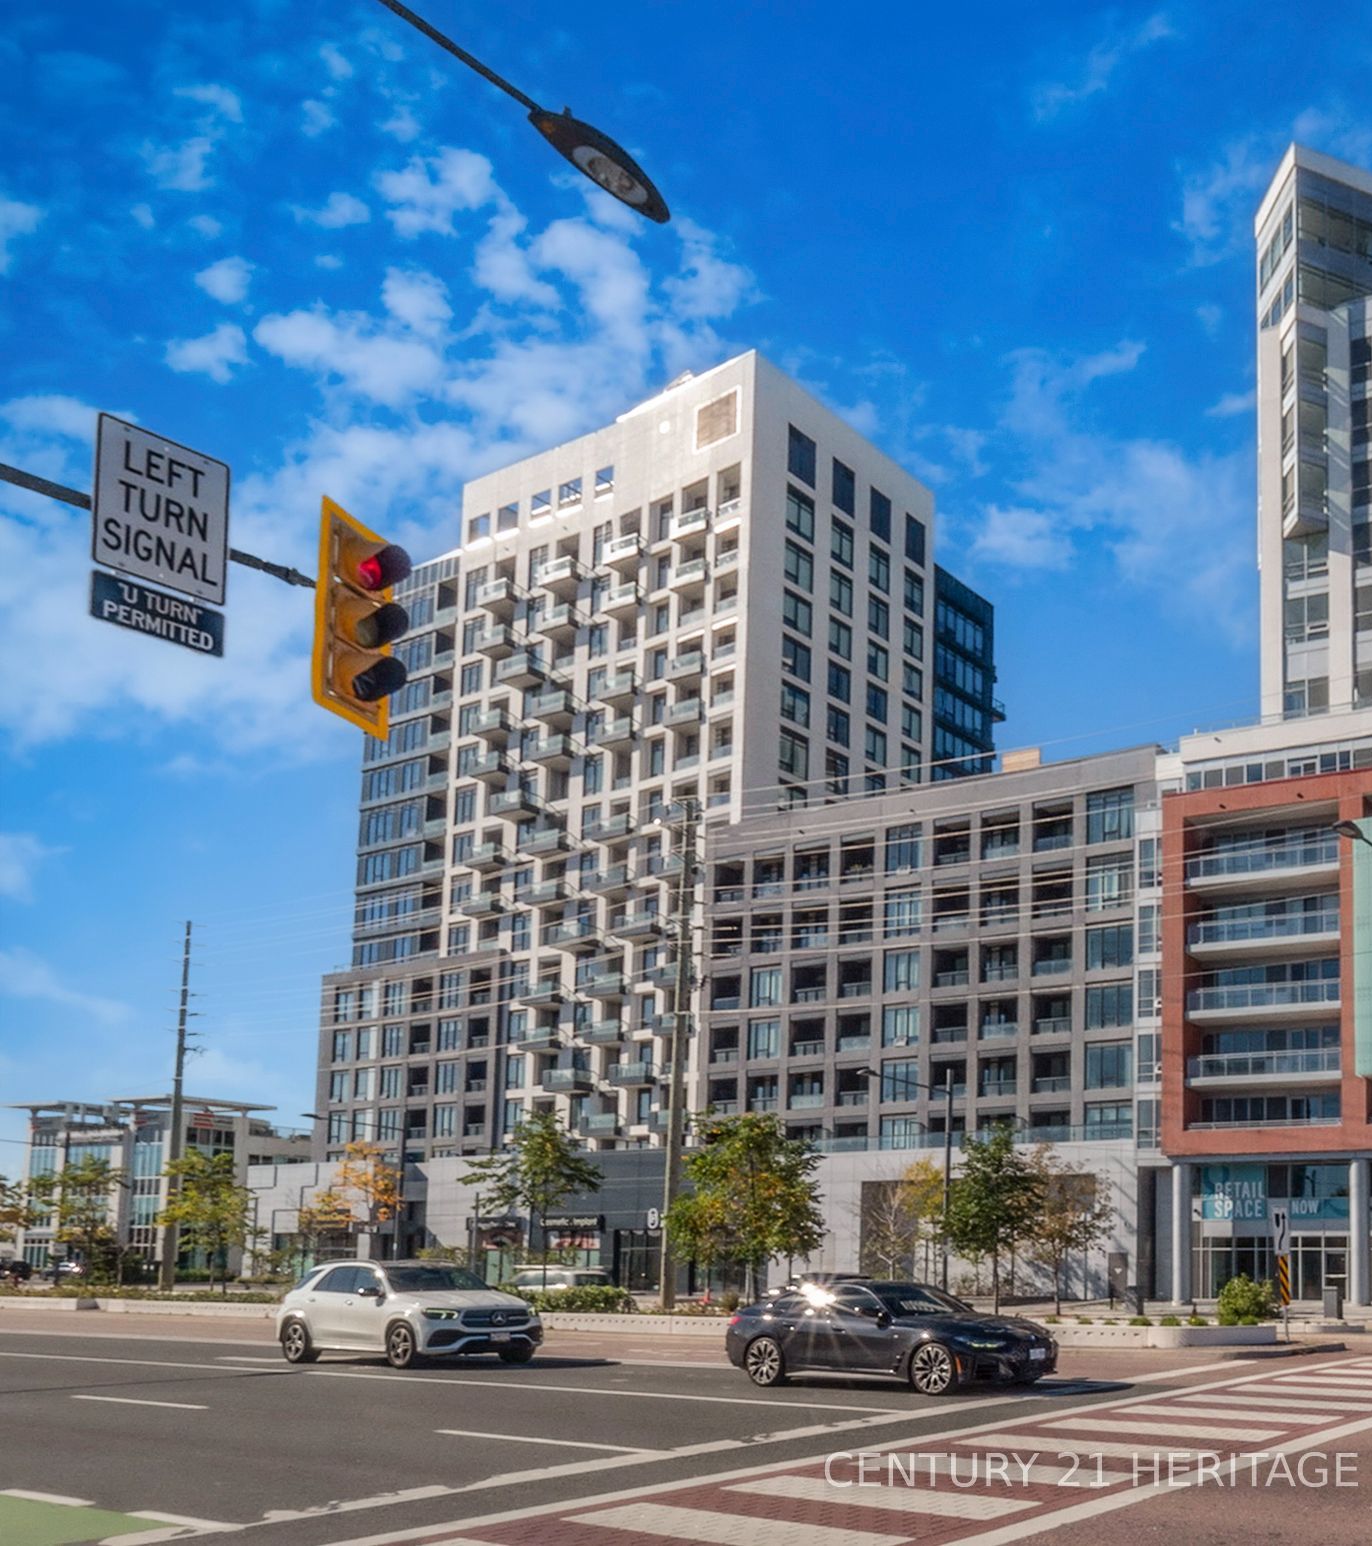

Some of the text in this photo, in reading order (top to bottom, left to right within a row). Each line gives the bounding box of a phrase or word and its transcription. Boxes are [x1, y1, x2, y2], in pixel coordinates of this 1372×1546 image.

[123, 439, 205, 498] LEFT
[118, 480, 209, 543] TURN
[102, 518, 218, 587] SIGNAL
[102, 599, 214, 651] PERMITTED
[1213, 1200, 1263, 1218] SPACE
[1214, 1181, 1266, 1200] RETAIL
[1291, 1199, 1320, 1215] NOW
